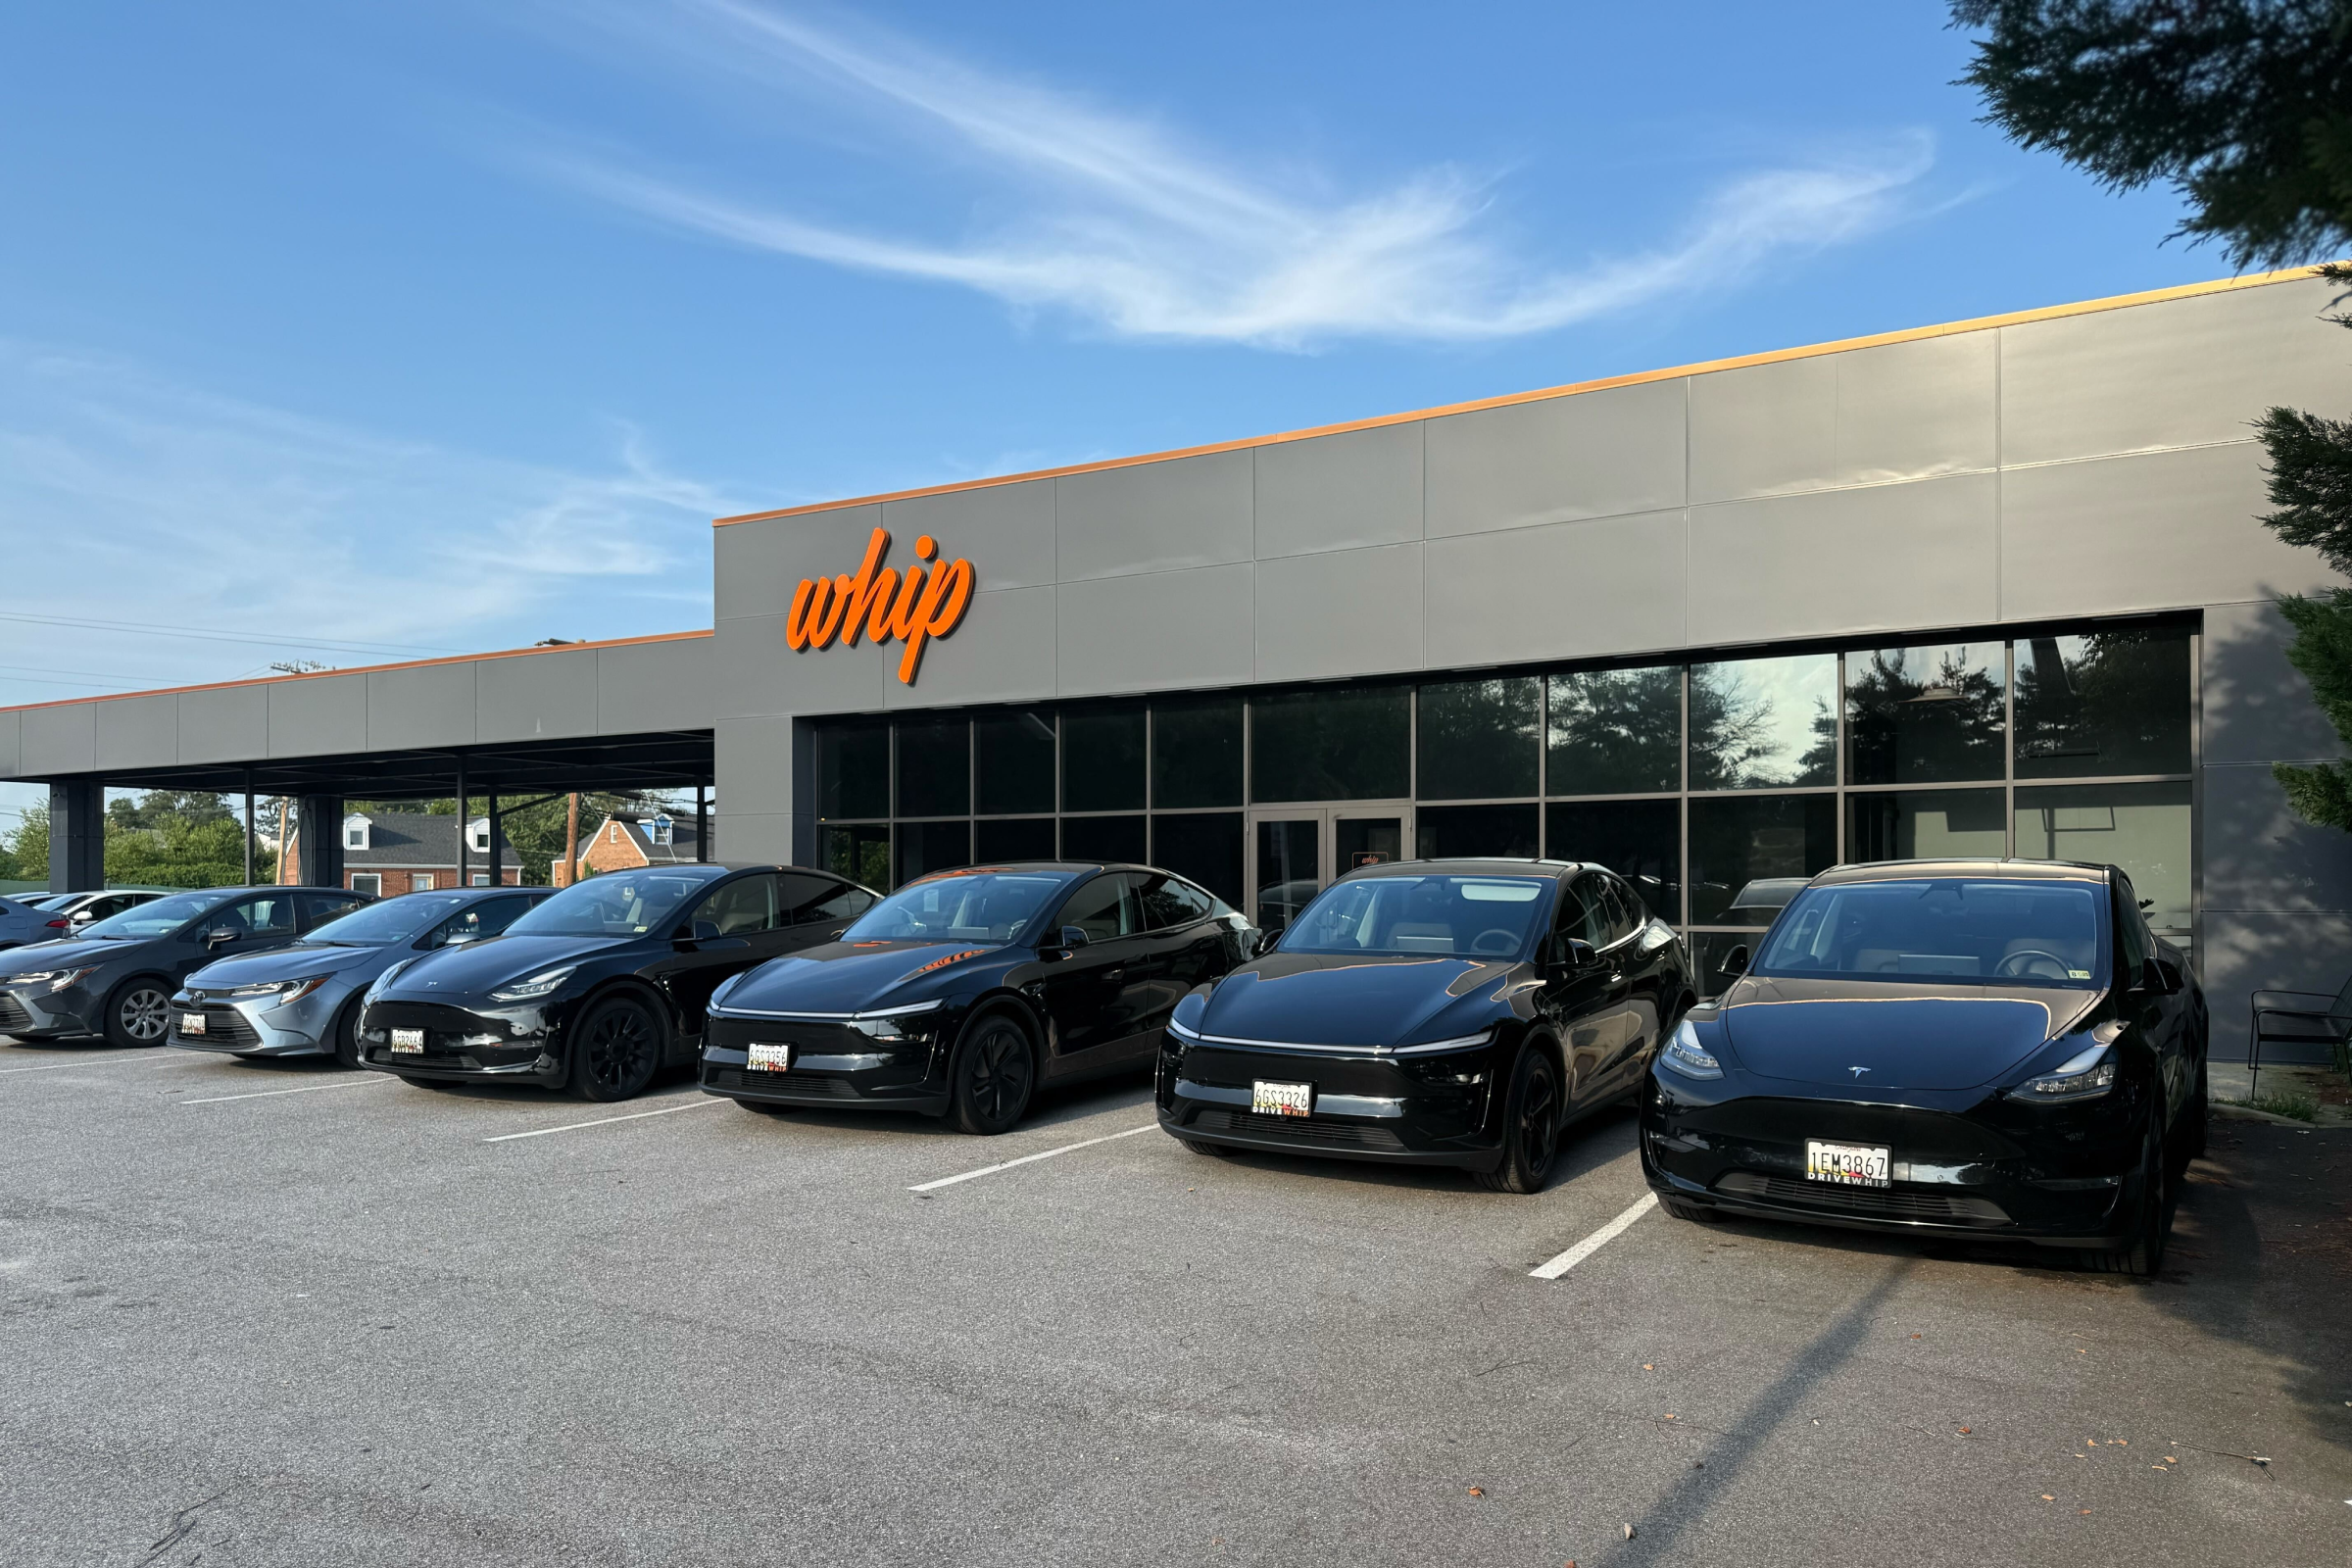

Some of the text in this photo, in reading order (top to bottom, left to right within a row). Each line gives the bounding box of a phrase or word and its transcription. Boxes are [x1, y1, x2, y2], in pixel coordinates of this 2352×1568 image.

[787, 527, 973, 684] whip
[1255, 1089, 1308, 1108] 6GS3326
[1812, 1152, 1886, 1177] 1EM3867
